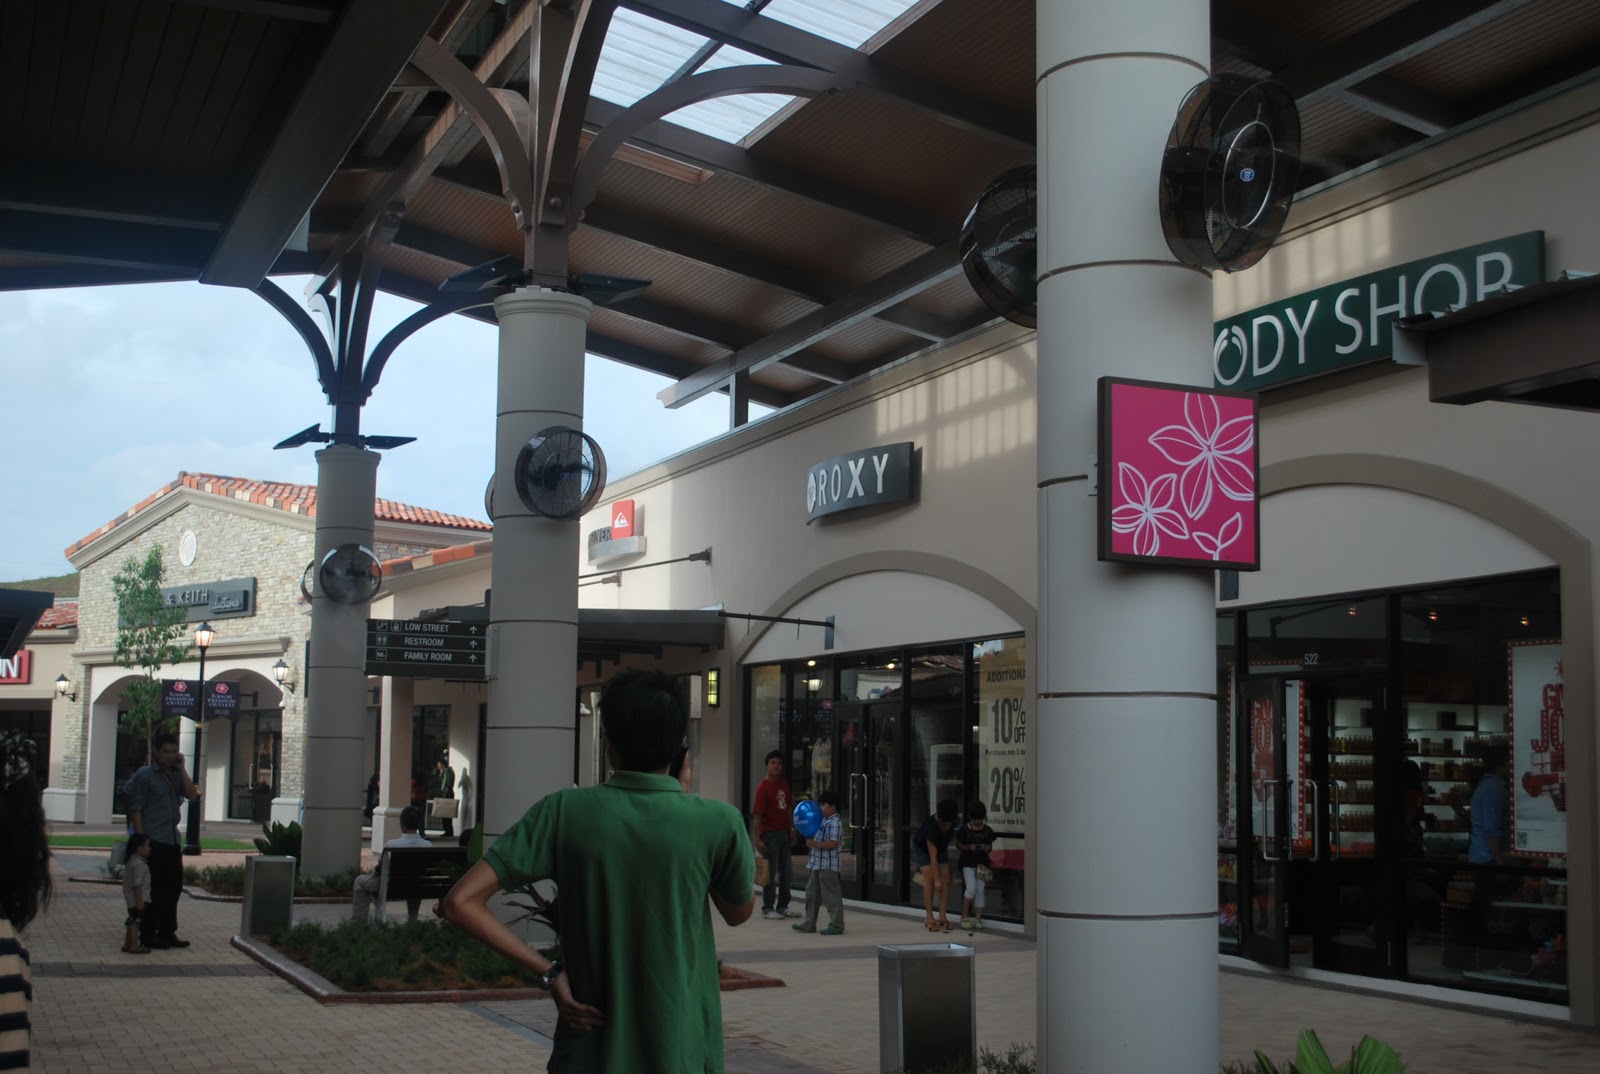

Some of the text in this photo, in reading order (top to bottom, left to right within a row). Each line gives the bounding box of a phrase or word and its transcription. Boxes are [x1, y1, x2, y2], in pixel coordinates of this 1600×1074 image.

[1213, 251, 1514, 386] ODY SHOP
[818, 453, 889, 507] ROXY
[166, 589, 208, 605] & KEITH
[404, 622, 450, 633] LOW STREET
[404, 637, 444, 647] RESTROOM
[404, 651, 453, 662] FAMILY ROOM
[1304, 652, 1319, 666] 522
[992, 697, 1026, 745] 10%
[1530, 709, 1564, 753] JO
[990, 767, 1025, 813] 20%
